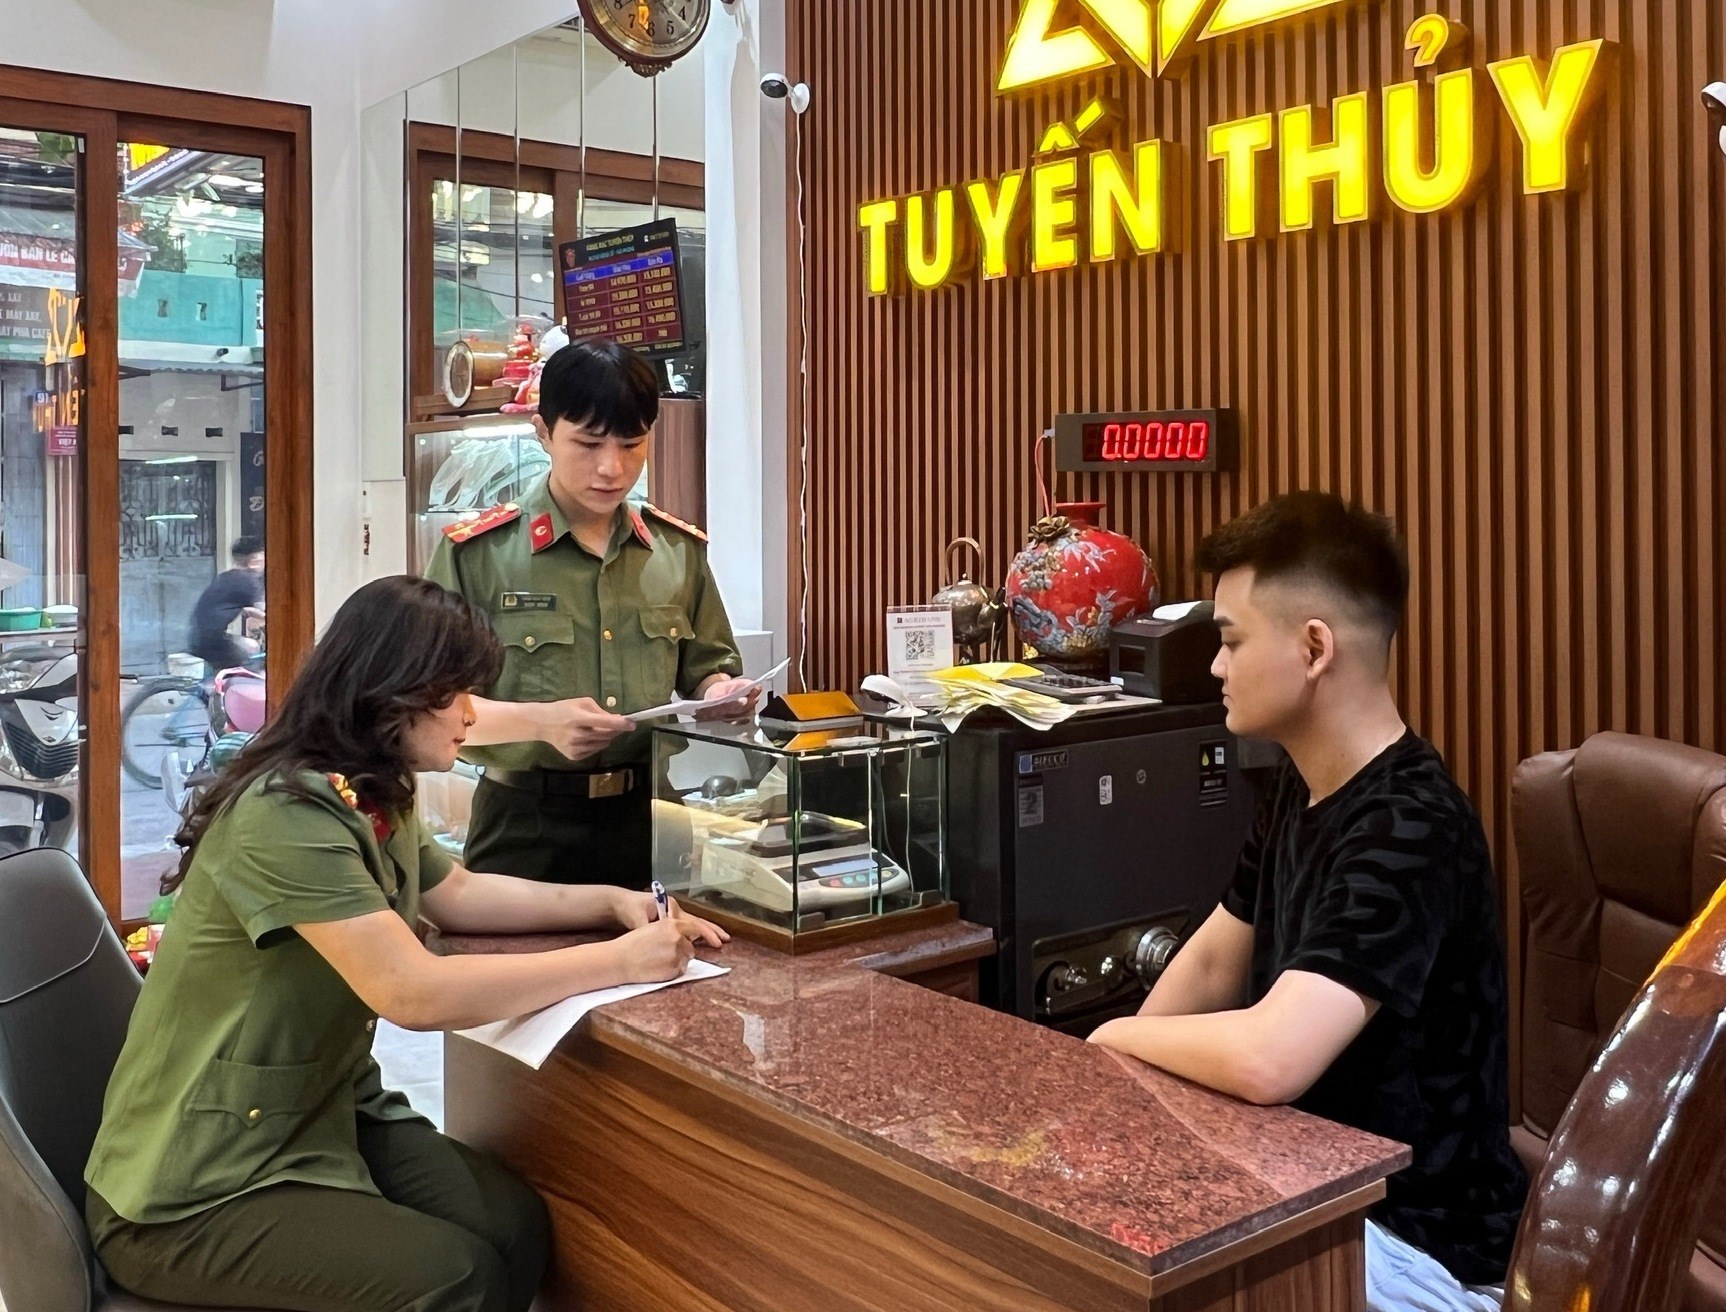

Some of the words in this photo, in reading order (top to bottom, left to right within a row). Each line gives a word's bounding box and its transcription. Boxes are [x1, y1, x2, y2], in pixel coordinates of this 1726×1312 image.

[628, 13, 637, 29] 7
[678, 6, 687, 21] 4
[645, 21, 656, 37] 6
[666, 20, 675, 35] 5
[858, 100, 1164, 297] TUYẾN
[1206, 14, 1604, 242] THỦY
